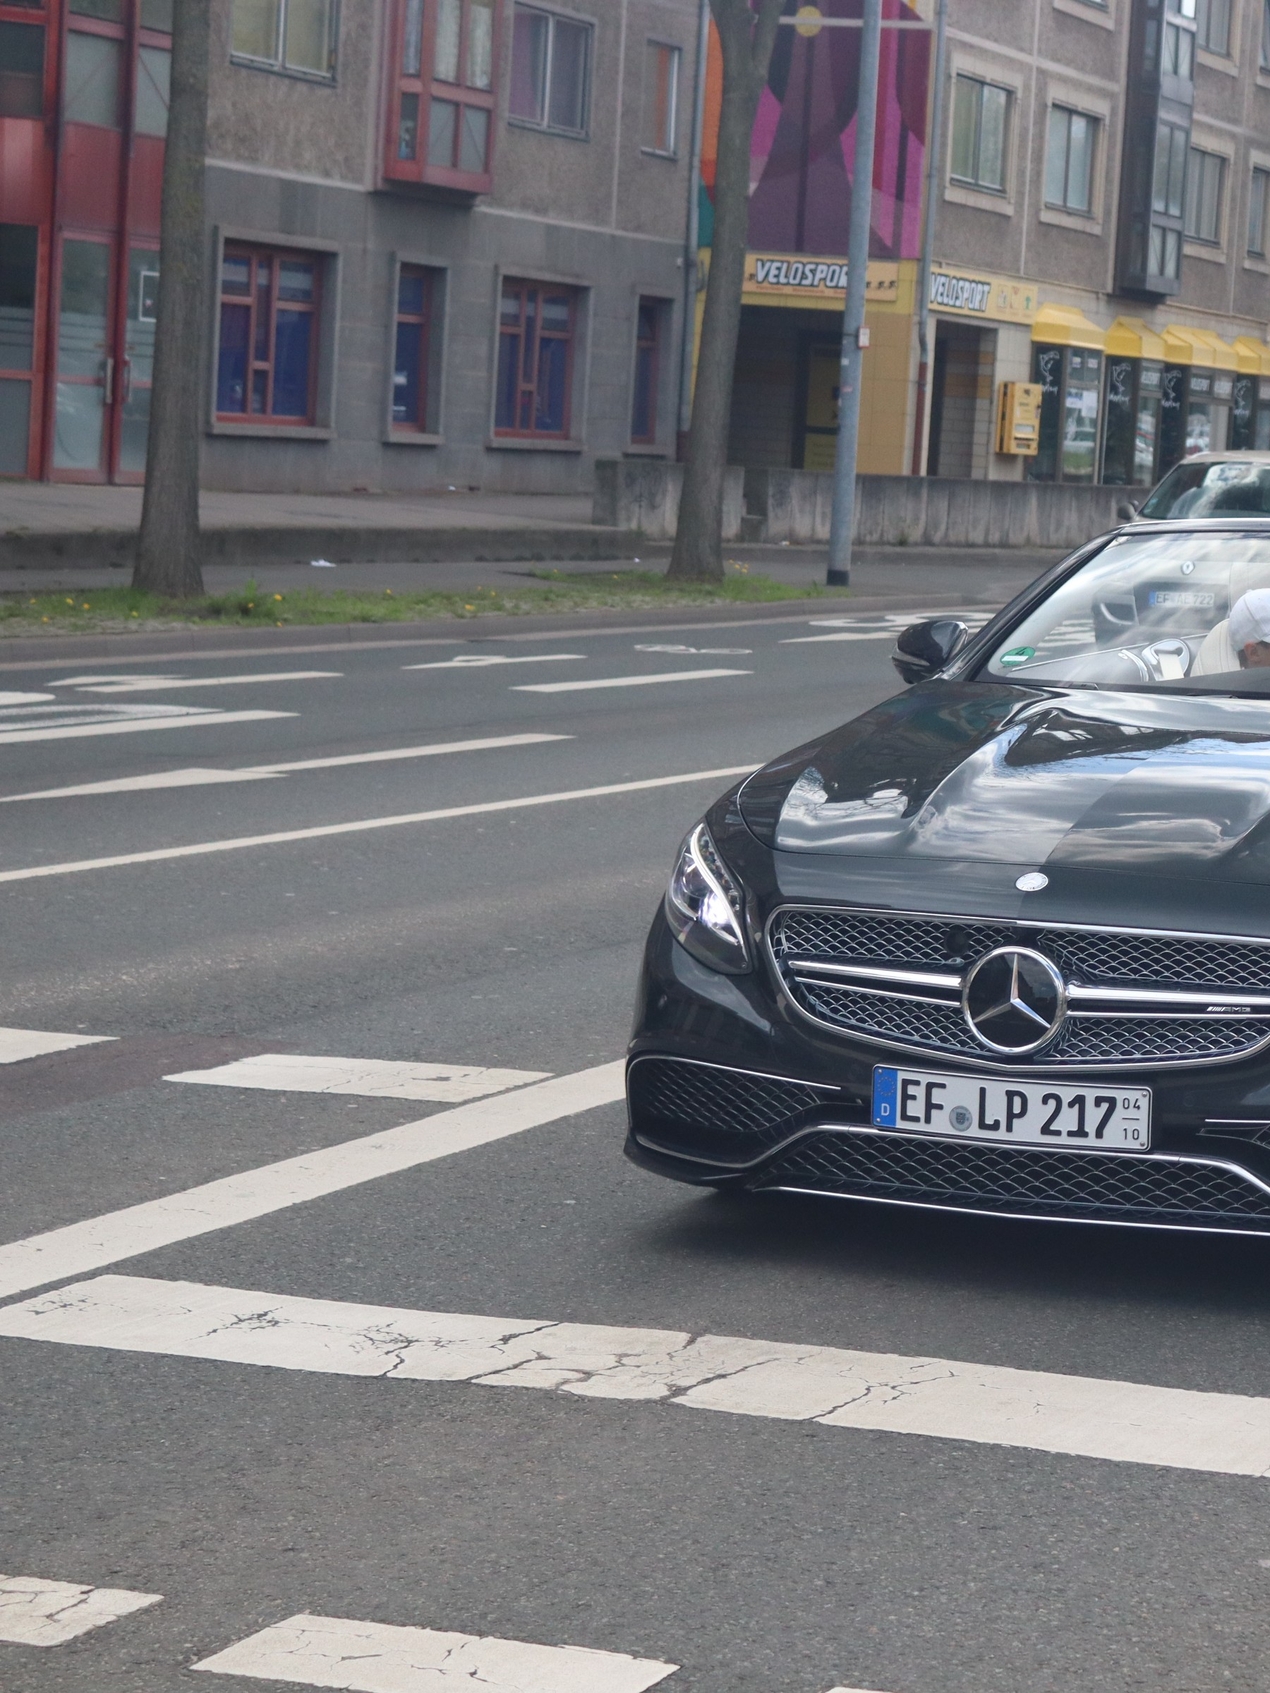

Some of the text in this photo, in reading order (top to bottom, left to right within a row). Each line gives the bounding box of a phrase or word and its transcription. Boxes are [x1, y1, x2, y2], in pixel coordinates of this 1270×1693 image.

[756, 259, 848, 288] VELOSPOR
[930, 273, 990, 312] VELOSPORT
[1156, 593, 1170, 603] EF
[880, 1077, 1118, 1139] D EF LP 217
[1122, 1097, 1141, 1111] 04
[1122, 1127, 1140, 1141] 10
